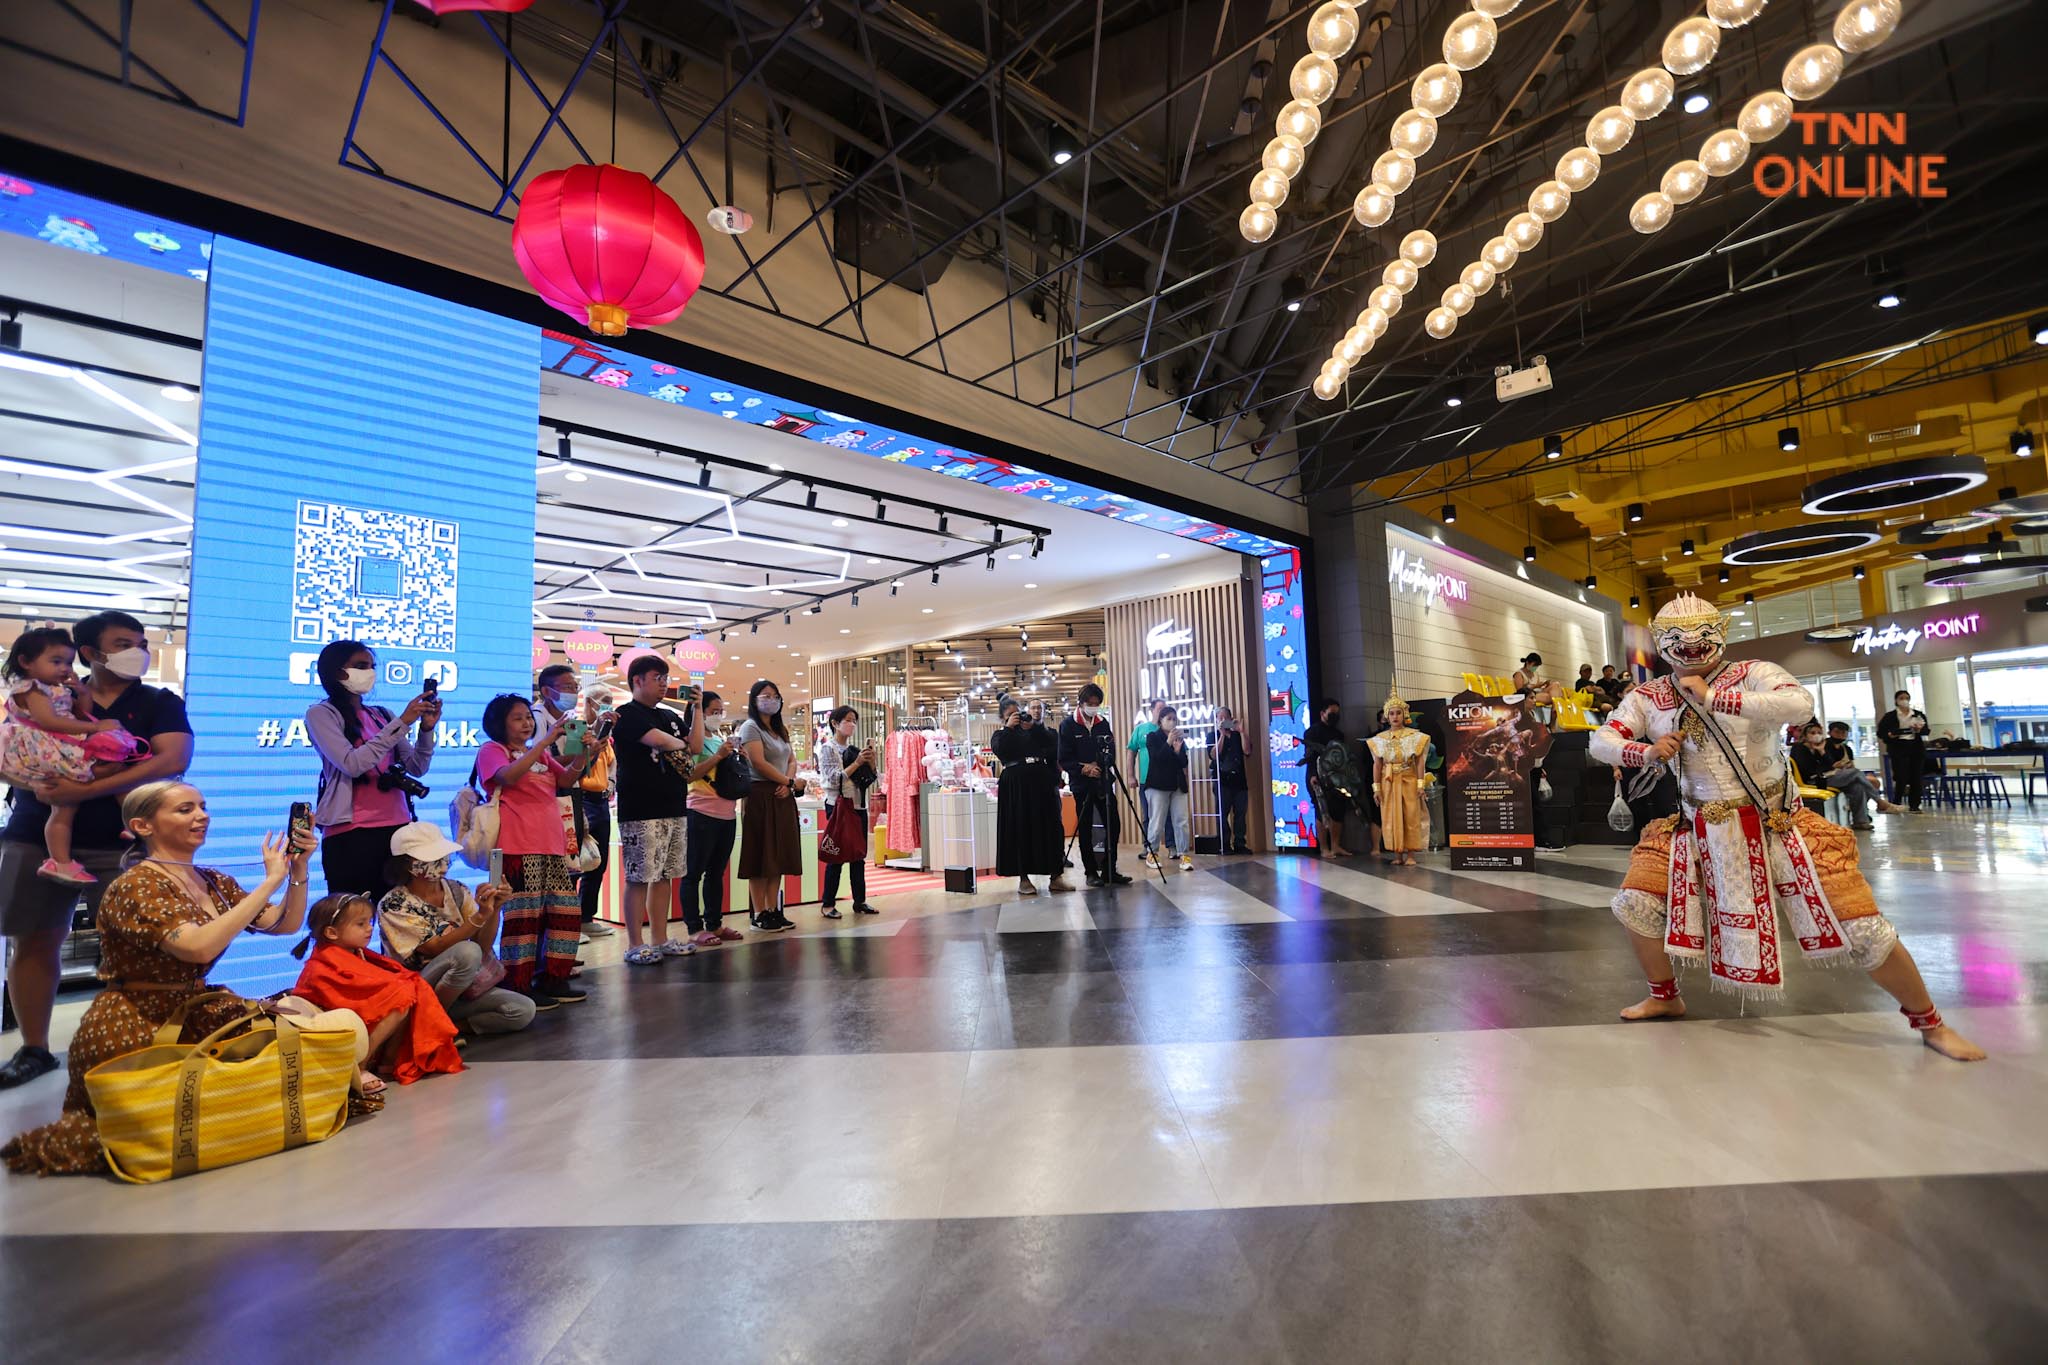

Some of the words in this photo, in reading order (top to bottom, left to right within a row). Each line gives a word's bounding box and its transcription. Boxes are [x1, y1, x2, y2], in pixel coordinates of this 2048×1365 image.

[1851, 622, 1922, 655] Meeting
[1923, 614, 1980, 640] POINT
[567, 641, 609, 654] HAPPY
[679, 650, 716, 661] LUCKY
[1140, 661, 1203, 700] DAKS
[1134, 704, 1214, 725] AOW
[1448, 706, 1493, 719] KHON
[282, 1050, 298, 1071] JIM
[179, 1070, 198, 1136] THOMPSON
[287, 1071, 302, 1135] THOMPSON
[178, 1138, 195, 1160] JIM
